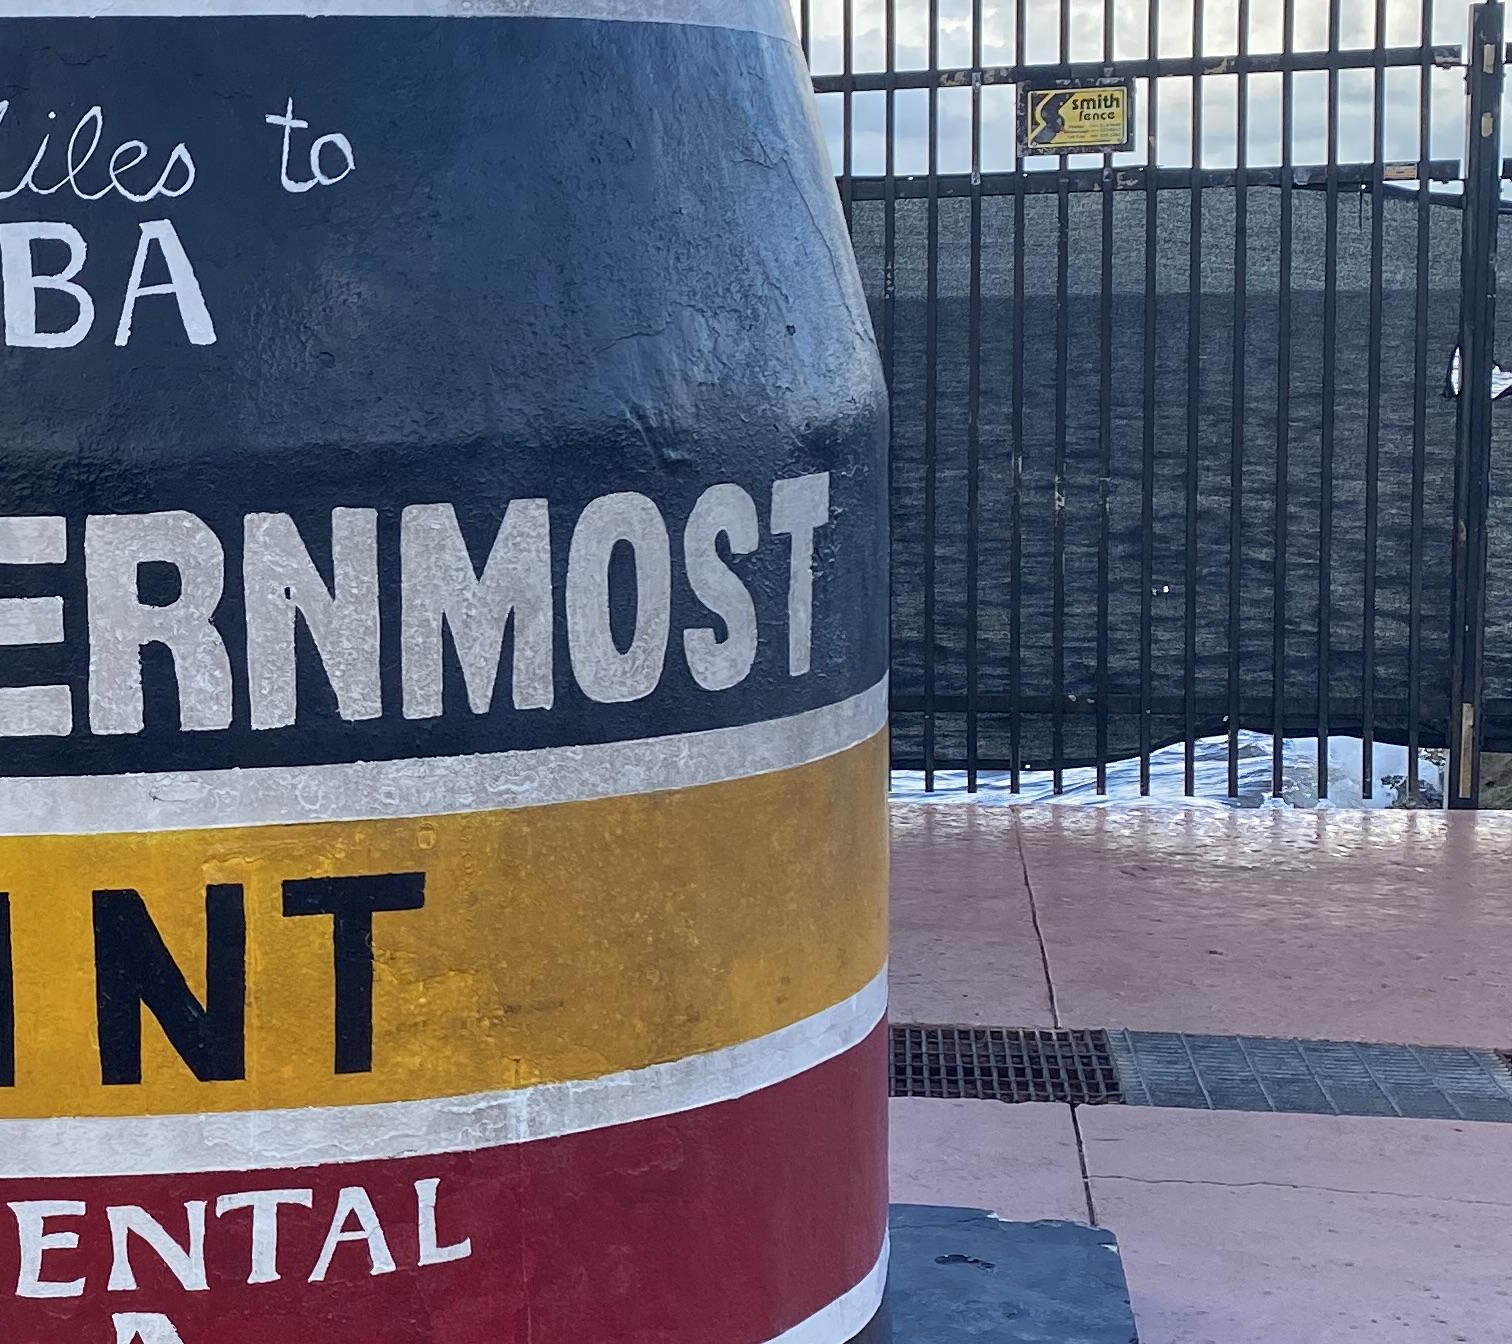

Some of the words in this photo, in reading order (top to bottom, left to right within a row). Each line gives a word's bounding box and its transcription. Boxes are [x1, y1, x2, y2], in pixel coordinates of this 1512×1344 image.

[1072, 94, 1119, 110] smith
[1079, 111, 1115, 121] fence
[265, 97, 355, 192] to
